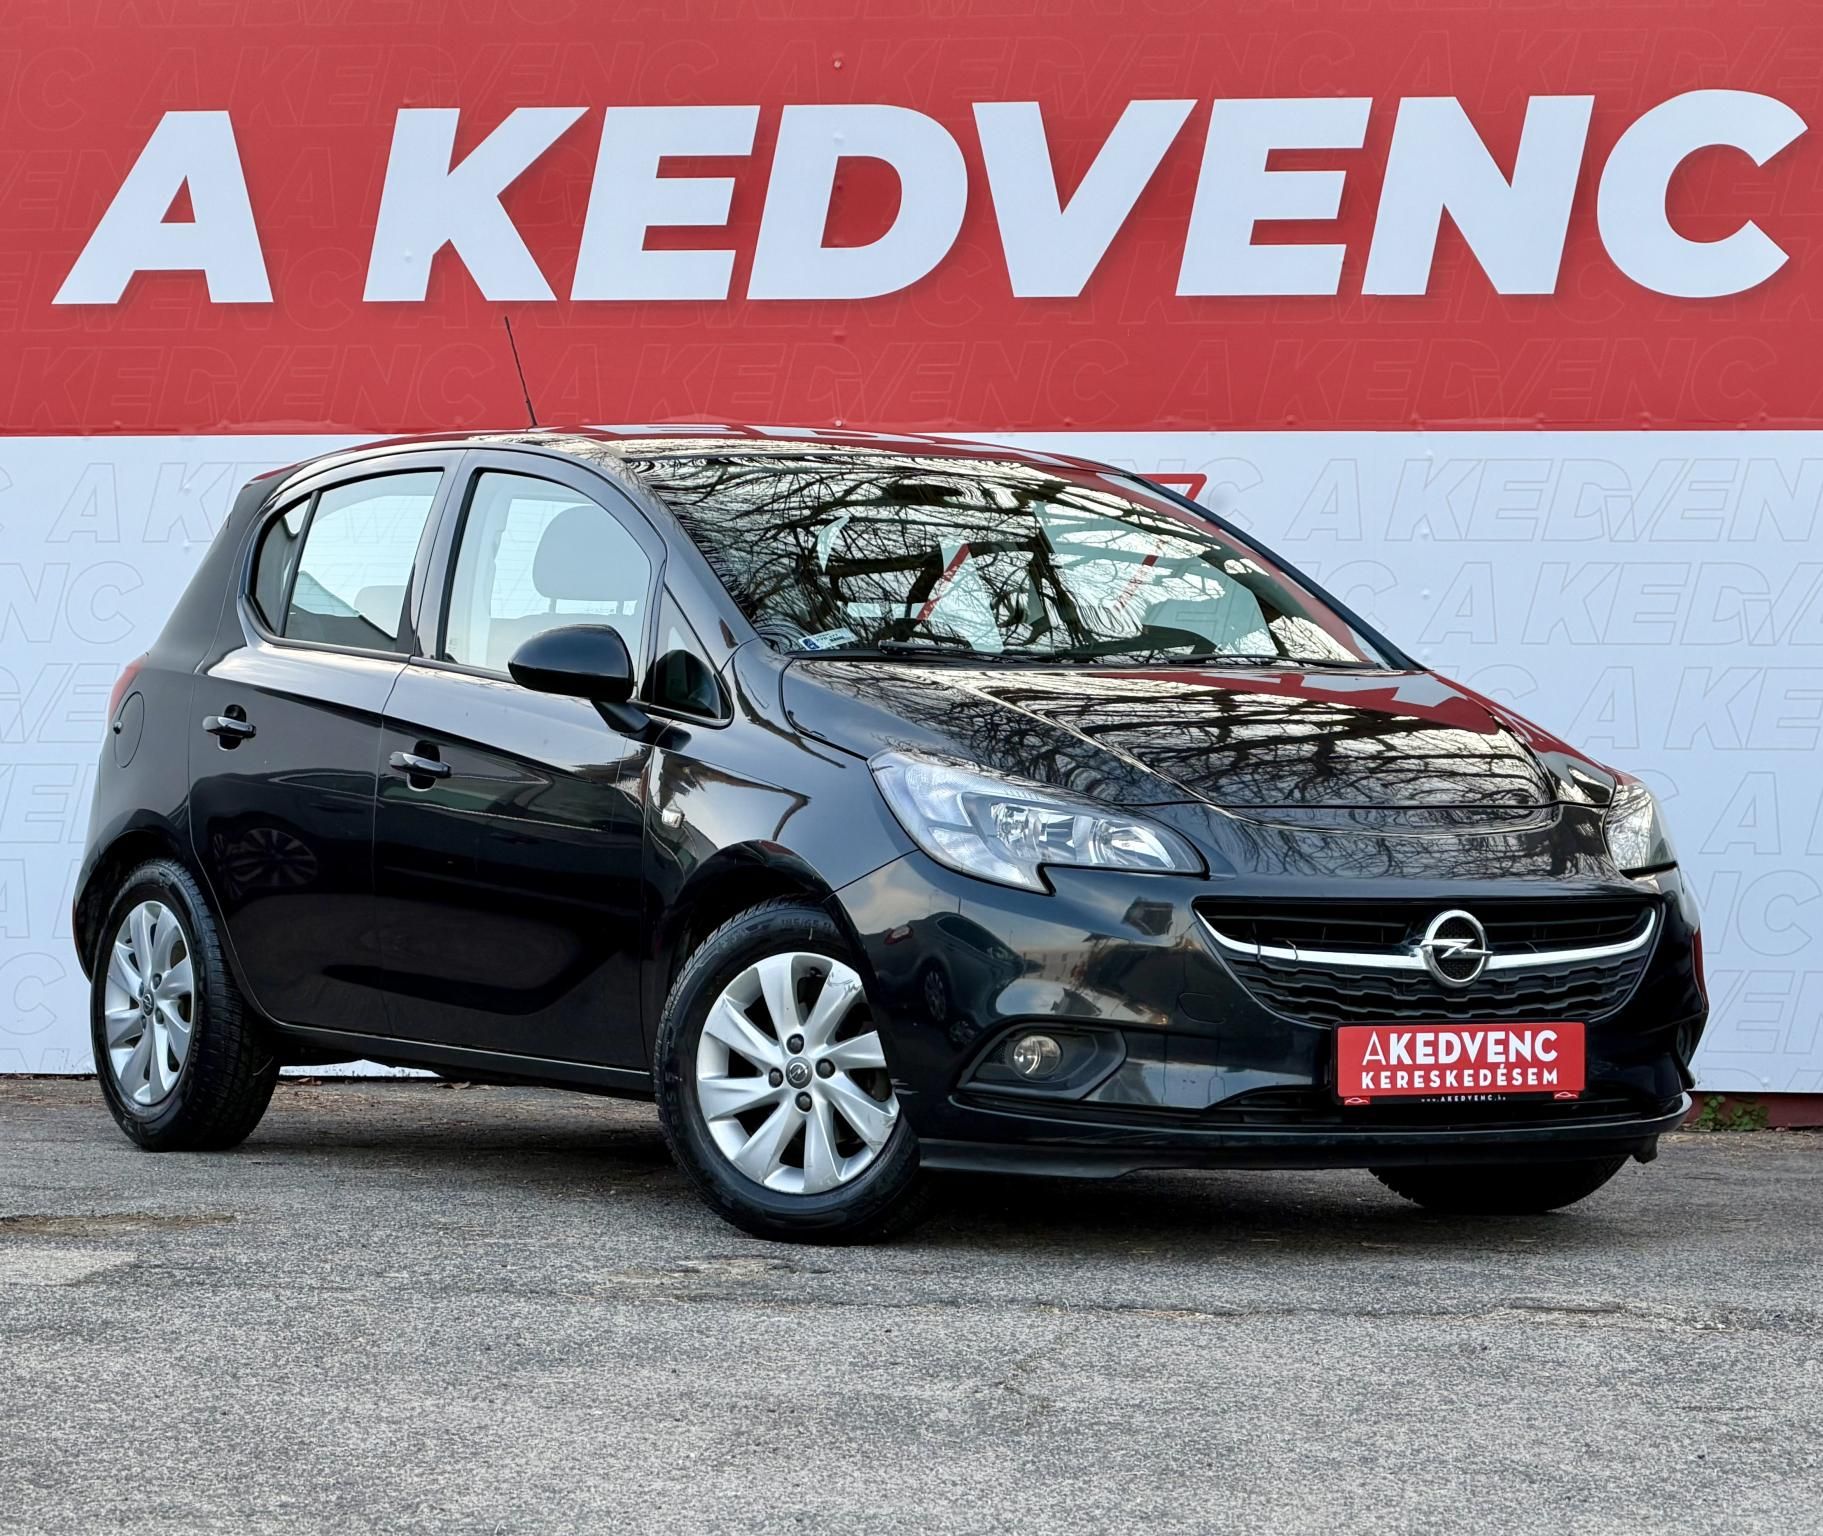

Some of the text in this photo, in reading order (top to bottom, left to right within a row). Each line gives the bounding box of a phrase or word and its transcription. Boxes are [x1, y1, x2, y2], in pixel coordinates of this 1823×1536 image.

[51, 110, 273, 304] A
[362, 88, 1809, 302] KEDVENC
[45, 460, 121, 543] A
[1282, 457, 1363, 542] A
[1415, 560, 1498, 645] A
[1563, 665, 1641, 750] A
[1698, 771, 1783, 856] A
[1361, 1029, 1558, 1066] AKEDVENC
[1361, 1064, 1558, 1089] KERESKEDÉSEM
